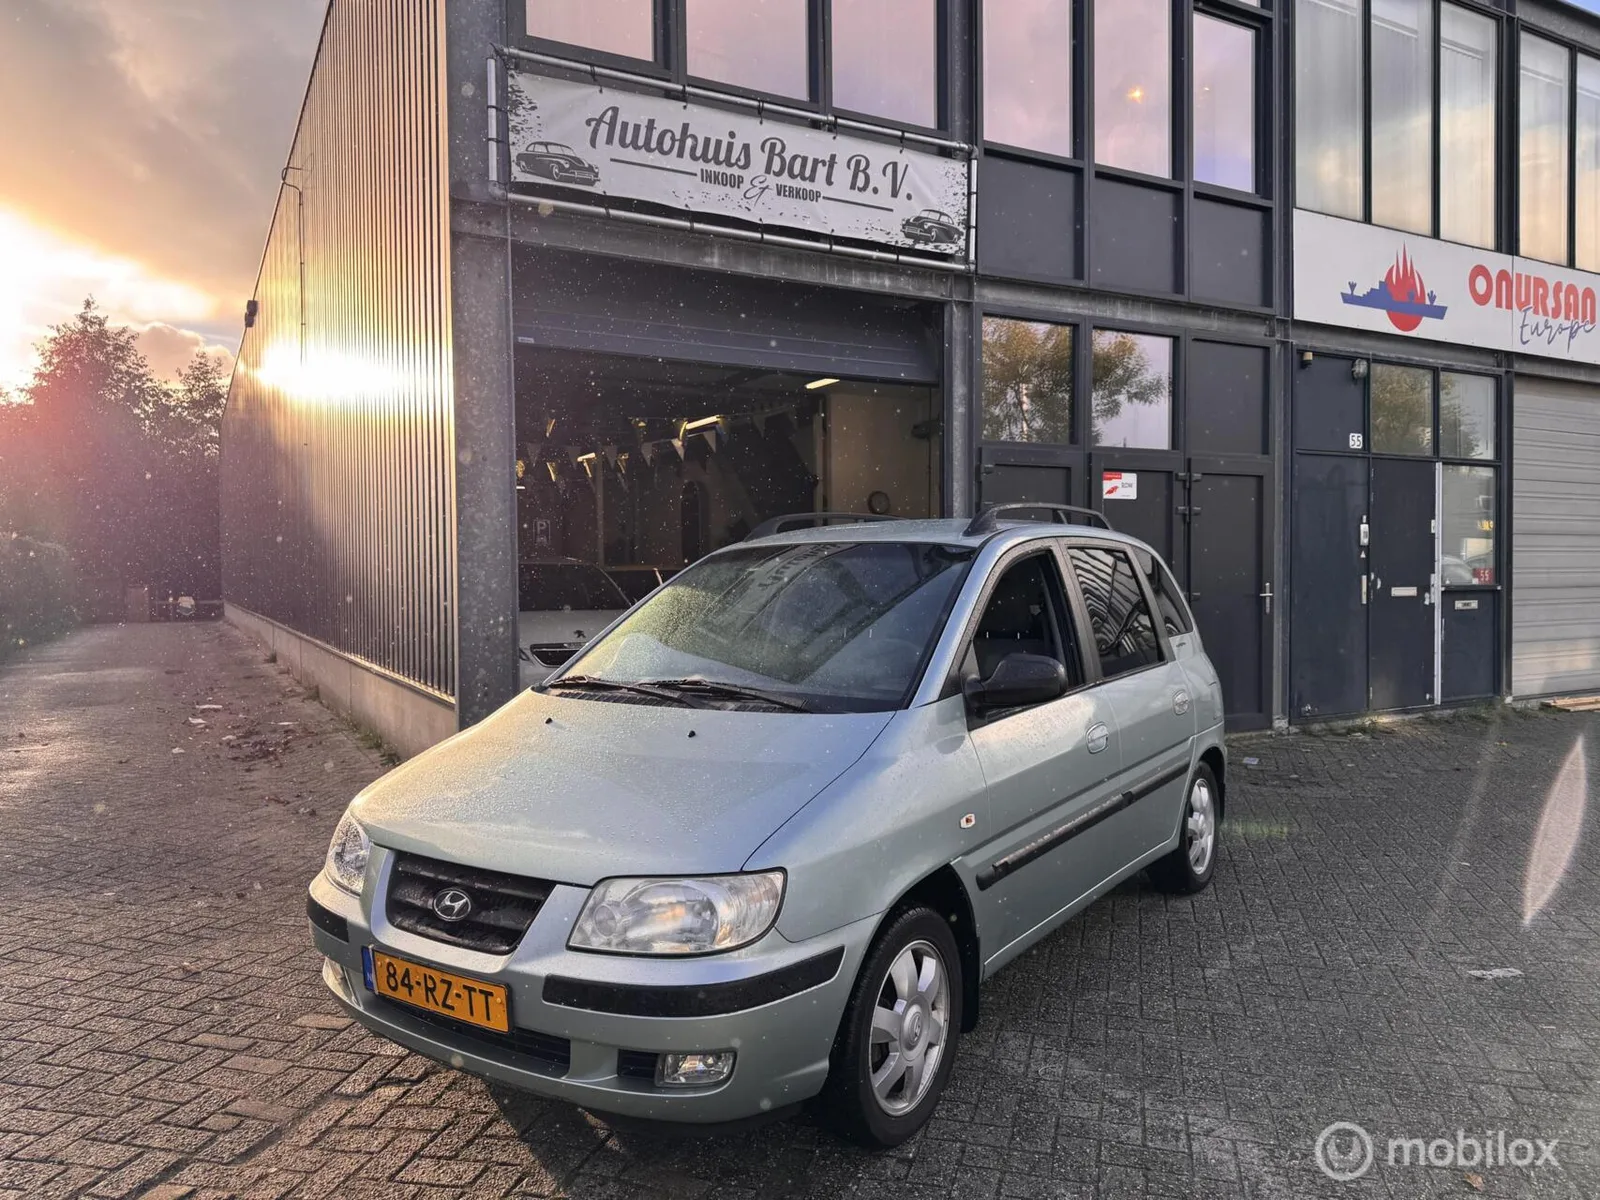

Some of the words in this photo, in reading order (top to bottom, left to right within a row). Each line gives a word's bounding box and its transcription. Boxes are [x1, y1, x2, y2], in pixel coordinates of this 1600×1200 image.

[585, 106, 752, 170] Autohuis
[760, 136, 838, 187] Bart
[846, 153, 913, 201] B.V.
[700, 168, 744, 189] INKOOP
[775, 183, 822, 202] VERKOOP
[1519, 306, 1597, 352] Europe
[1350, 435, 1362, 447] 55
[386, 961, 494, 1022] 84-RZ-TT
